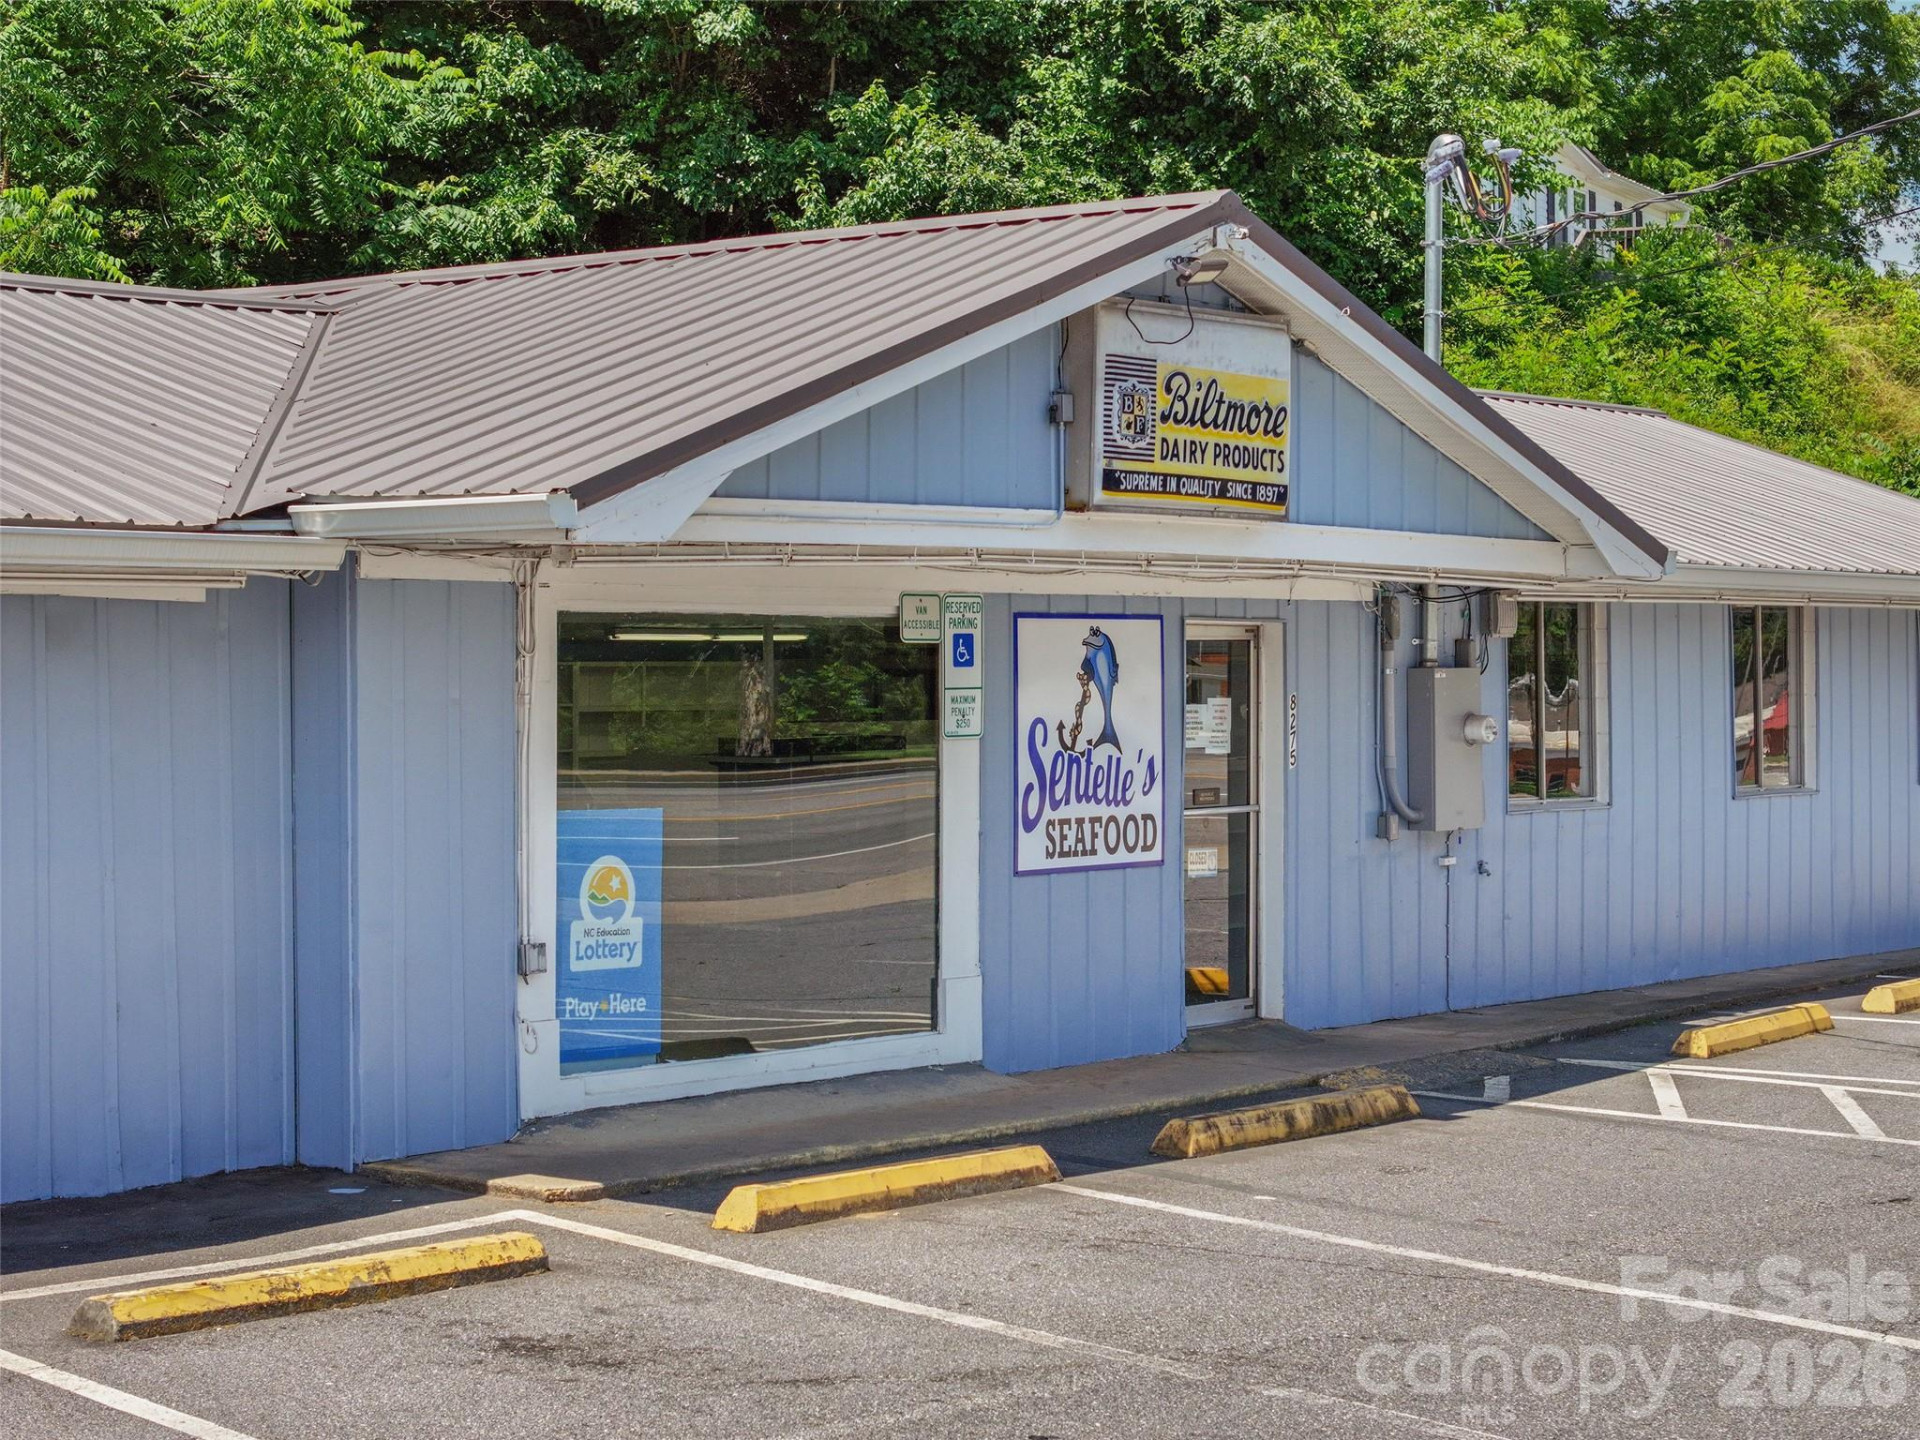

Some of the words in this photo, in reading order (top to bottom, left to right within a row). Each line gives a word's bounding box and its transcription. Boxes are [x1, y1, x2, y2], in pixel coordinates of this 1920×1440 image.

[1124, 395, 1133, 413] B
[1160, 371, 1288, 439] Biltmore
[1160, 437, 1210, 465] DAIRY
[1213, 442, 1285, 474] PRODUCTS
[1166, 475, 1177, 493] IN
[1180, 477, 1221, 497] QUALITY
[1226, 481, 1252, 499] SINCE
[915, 605, 928, 614] VAN
[945, 601, 981, 614] RESERVED
[903, 619, 940, 630] ACCESSIBLE
[948, 617, 978, 630] PARKING
[950, 695, 976, 704] MAXIMUM
[951, 707, 975, 717] PENALTY
[956, 718, 971, 729] $250
[1021, 717, 1159, 833] Sentelle's
[1045, 813, 1157, 860] SEAFOOD
[584, 928, 595, 938] NC
[596, 927, 631, 937] Education
[575, 939, 638, 962] Lottery
[565, 997, 599, 1021] Play
[609, 994, 647, 1014] Here
